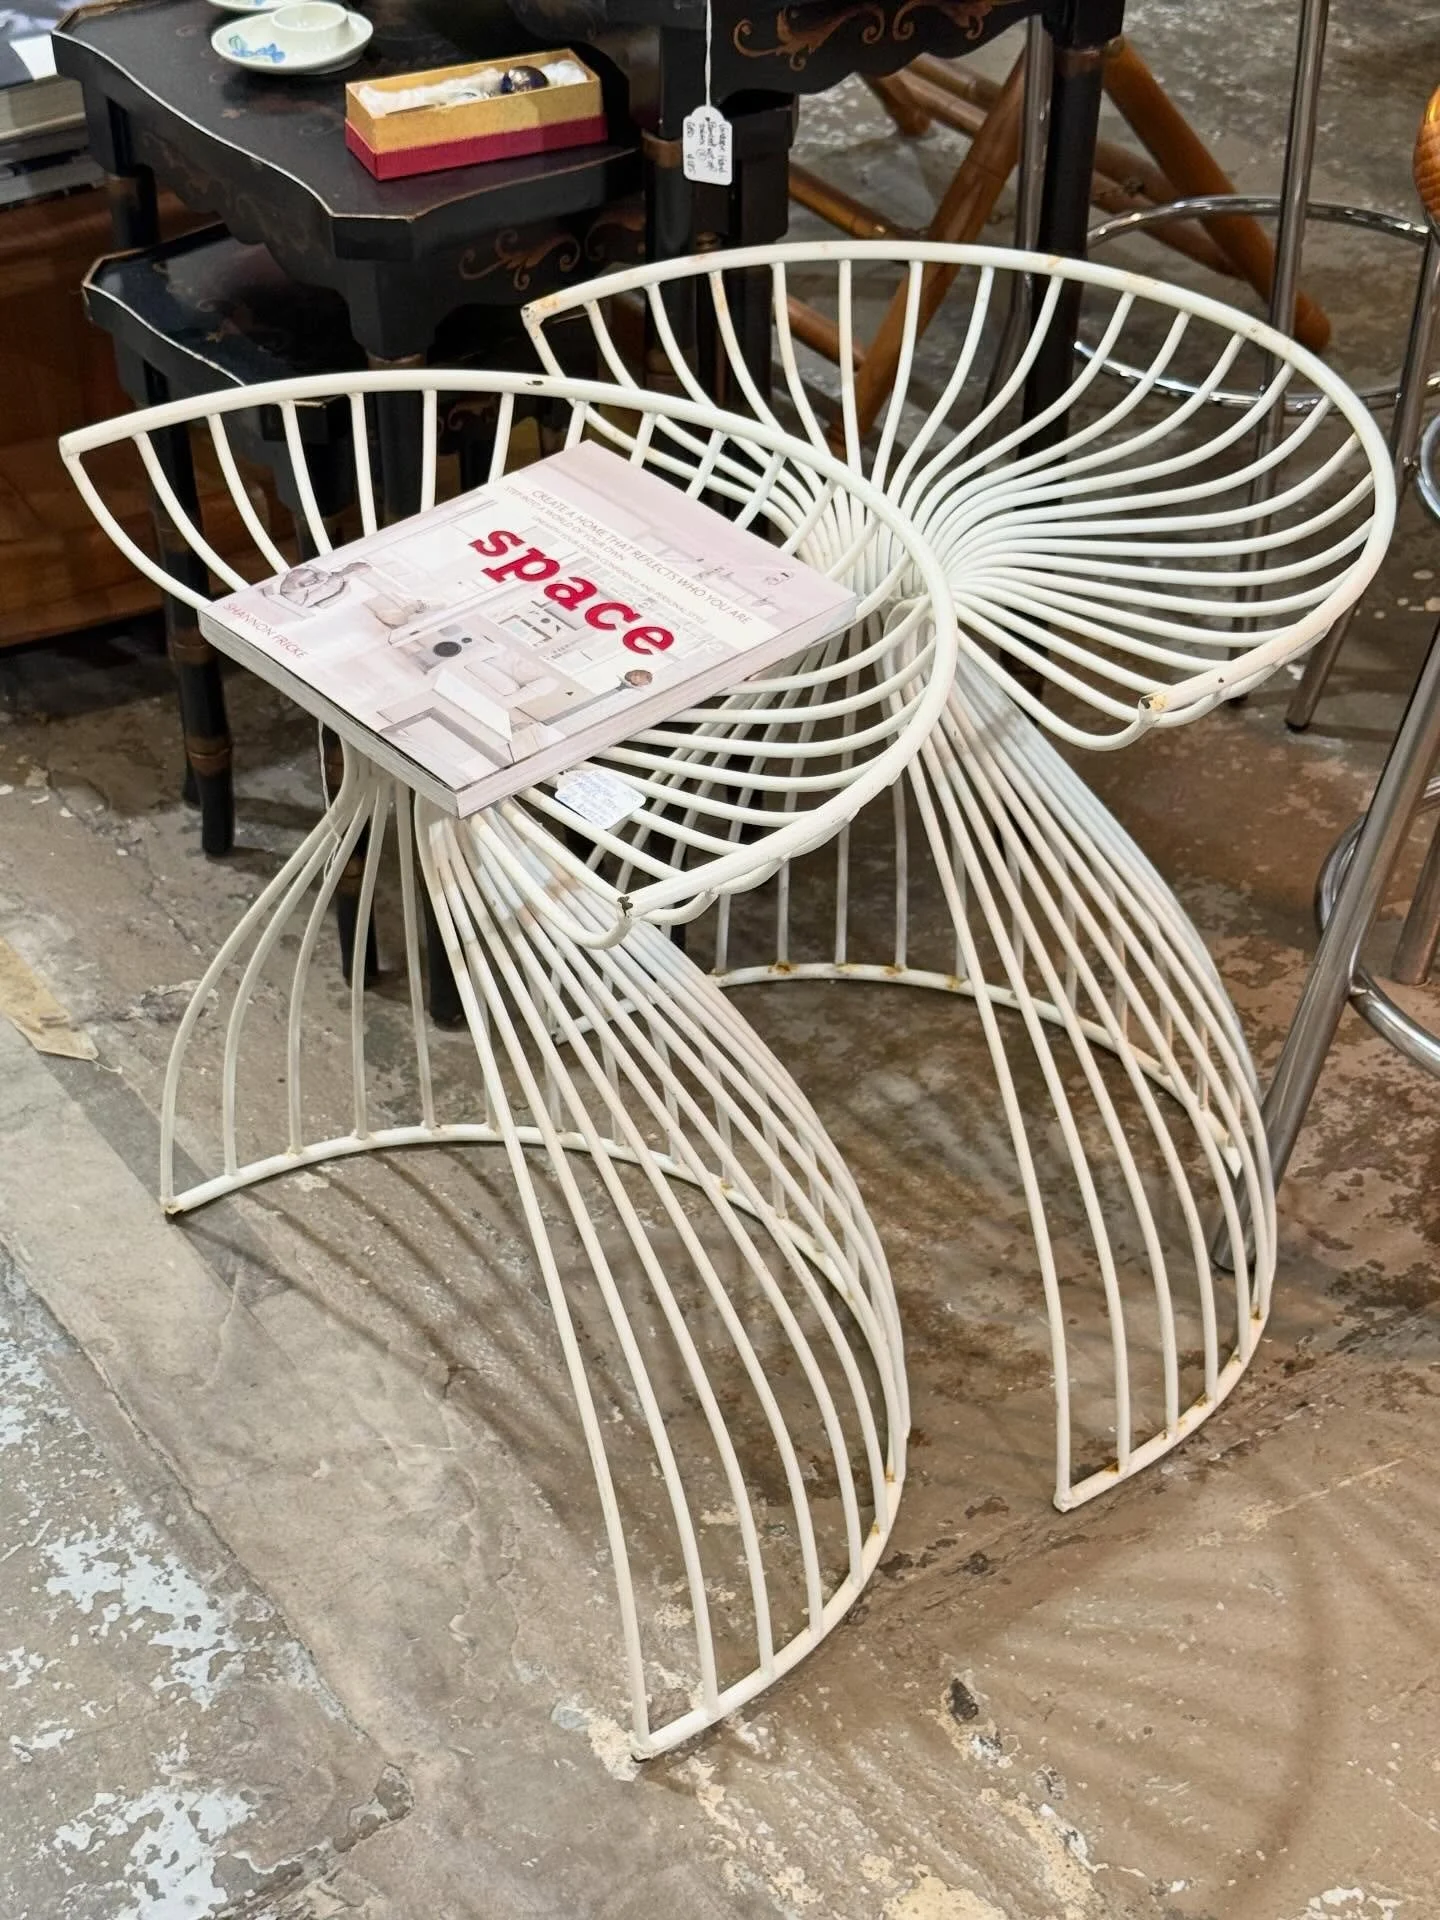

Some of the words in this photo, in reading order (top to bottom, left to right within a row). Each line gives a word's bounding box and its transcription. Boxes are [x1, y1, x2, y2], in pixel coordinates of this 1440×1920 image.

[468, 530, 675, 655] space
[529, 488, 570, 513] CREATE
[571, 514, 609, 537] HOME
[602, 533, 636, 553] THAT
[629, 549, 681, 580] REFLECTS
[673, 576, 709, 597] WHO
[702, 594, 733, 612] YOU
[725, 608, 754, 625] ARE
[223, 602, 273, 635] SHANNON
[272, 631, 309, 657] FRICKE
